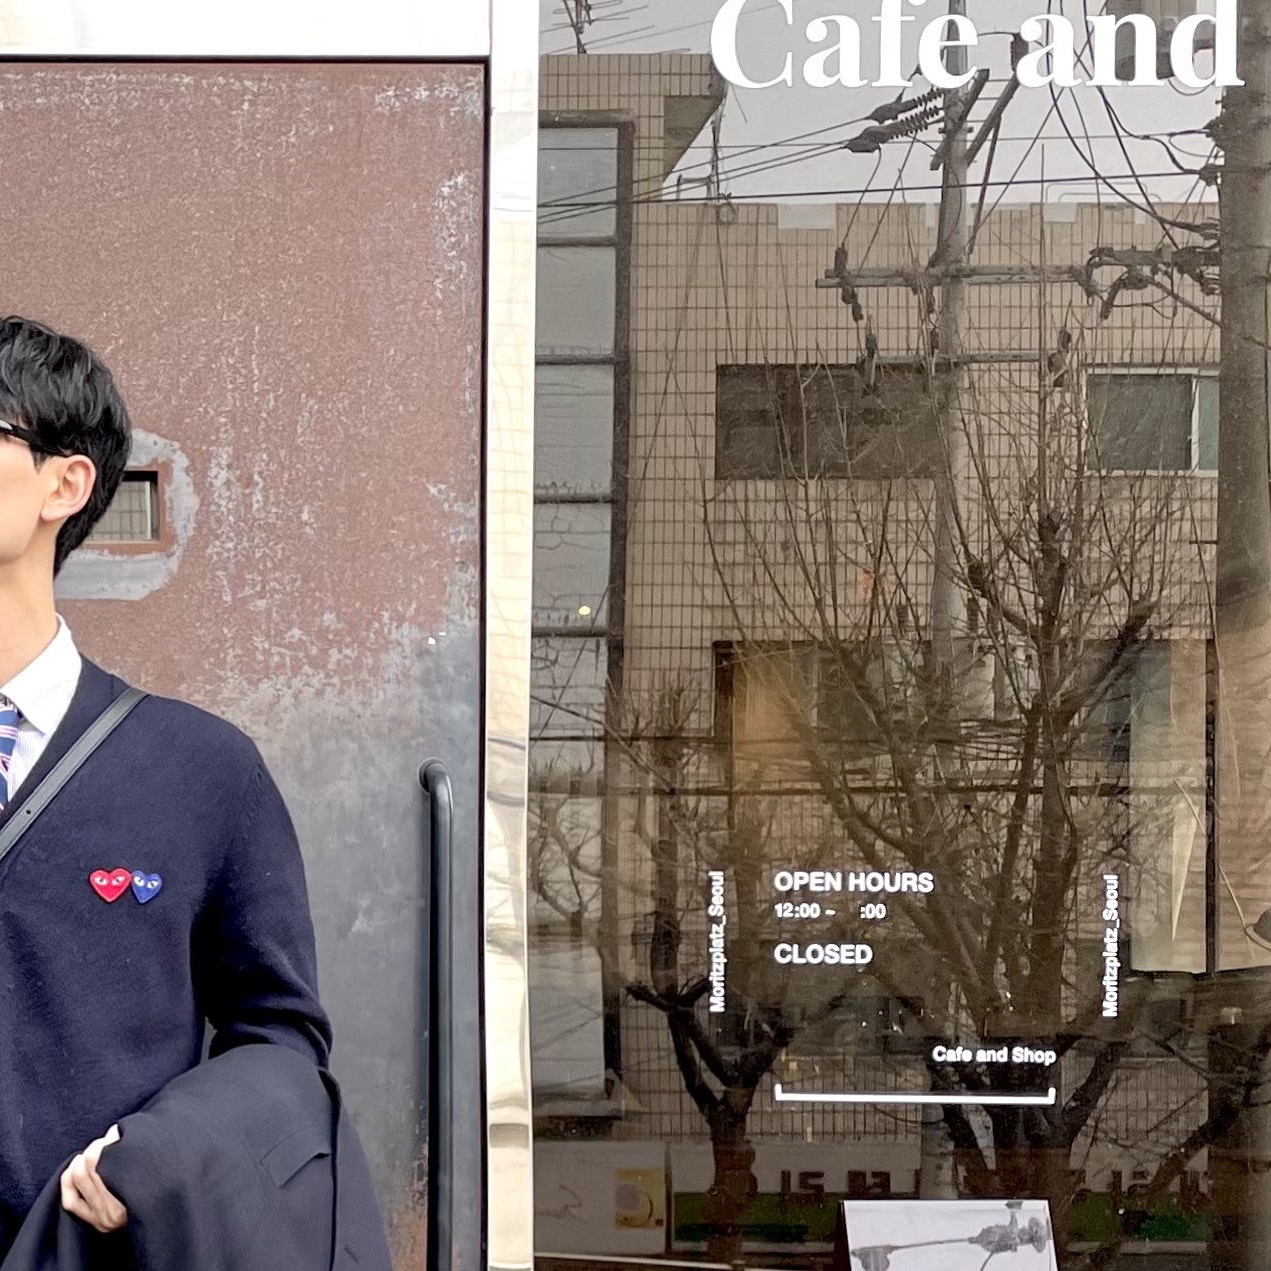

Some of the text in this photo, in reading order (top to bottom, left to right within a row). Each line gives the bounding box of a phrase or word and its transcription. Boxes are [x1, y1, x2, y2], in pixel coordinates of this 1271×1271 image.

[709, 0, 1246, 89] Cafe and
[774, 871, 934, 893] OPEN HOURS
[774, 902, 821, 919] 12:00
[774, 943, 873, 965] CLOSED
[932, 1045, 1057, 1067] Cafe and Shop
